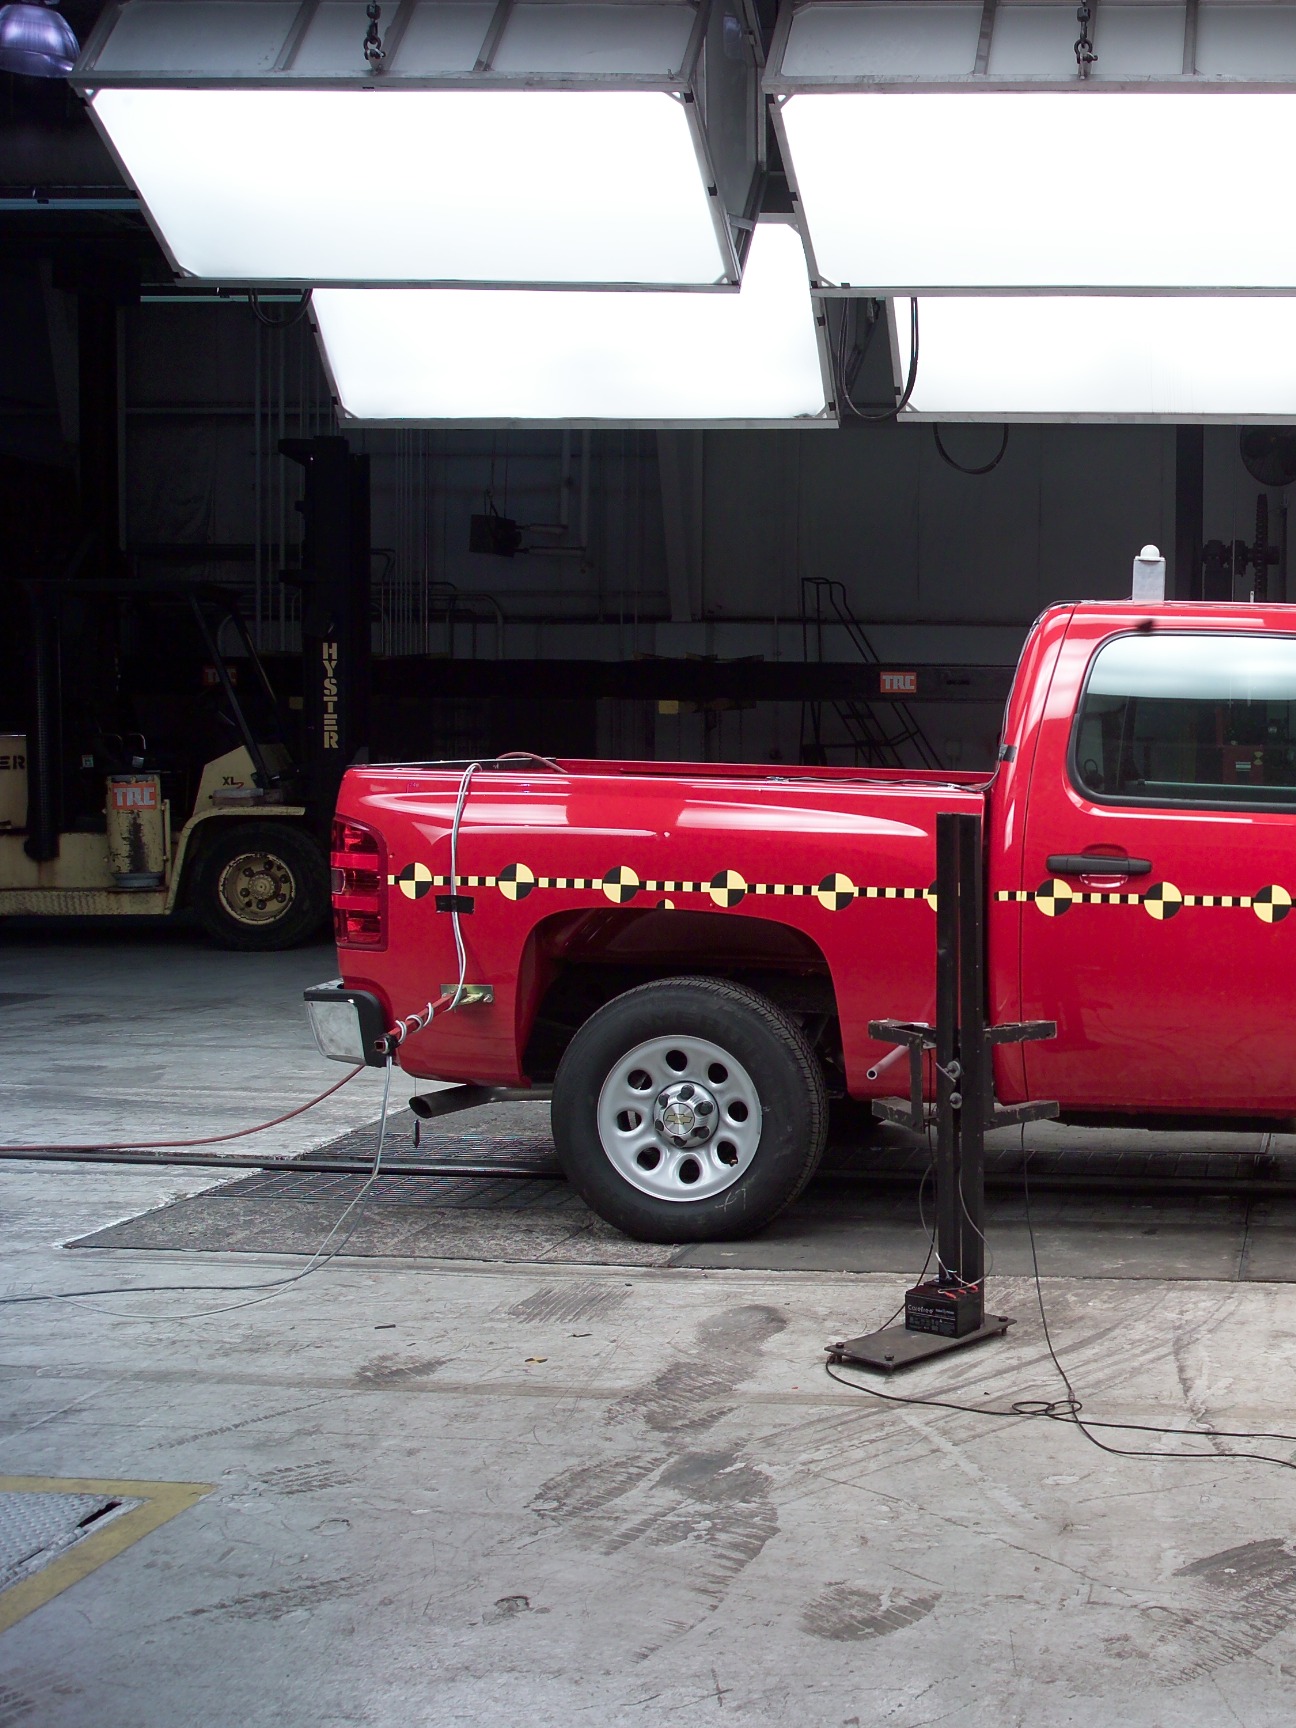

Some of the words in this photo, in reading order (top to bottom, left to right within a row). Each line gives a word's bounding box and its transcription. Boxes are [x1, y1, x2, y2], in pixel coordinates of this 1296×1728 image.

[882, 675, 915, 690] TRC
[322, 642, 339, 749] HYSTER
[113, 787, 155, 806] TRC
